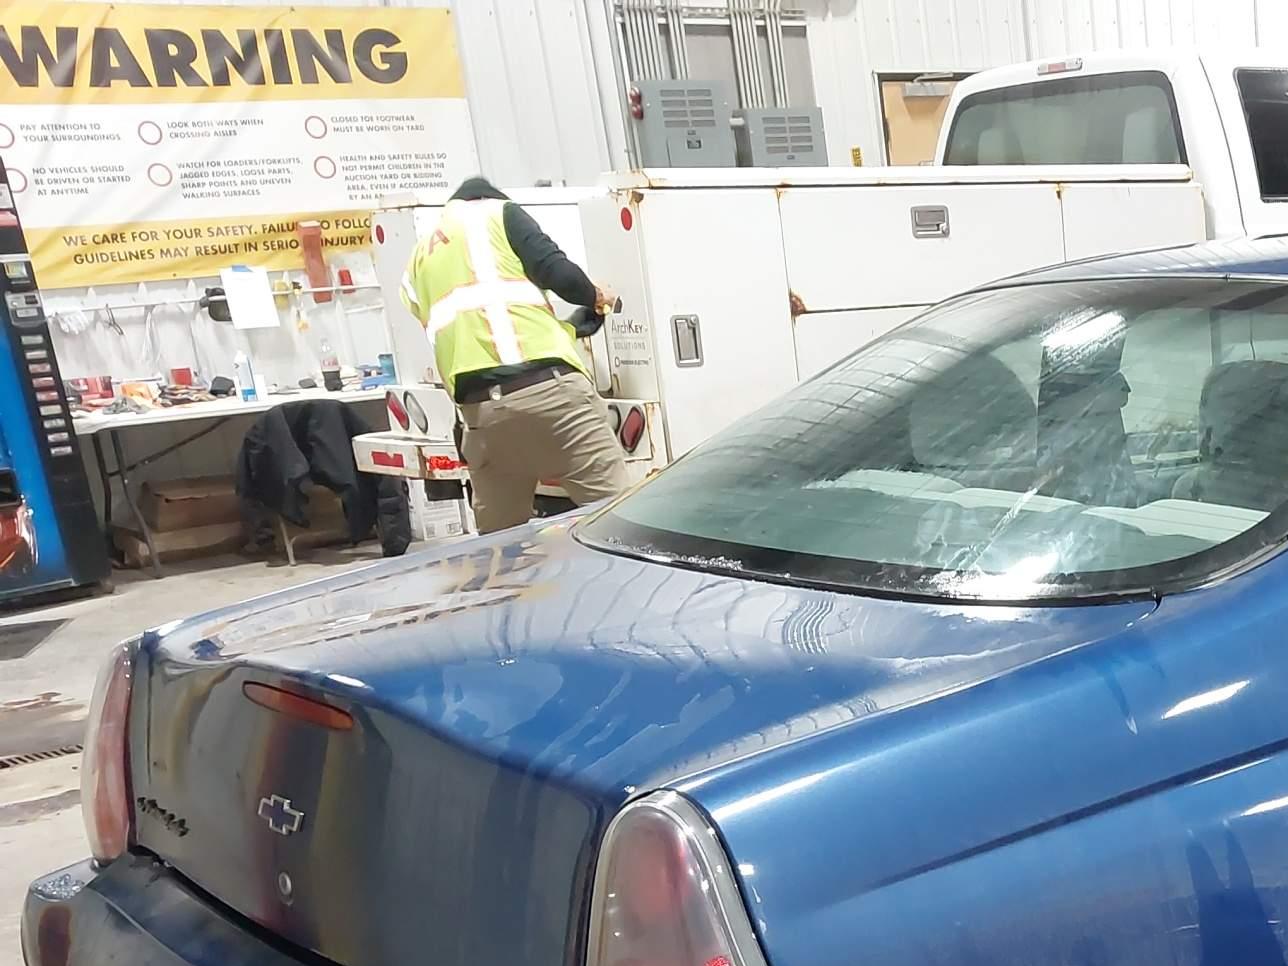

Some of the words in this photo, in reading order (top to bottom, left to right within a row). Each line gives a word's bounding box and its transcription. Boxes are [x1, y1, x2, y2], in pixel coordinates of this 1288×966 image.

[0, 25, 408, 88] WARNING
[167, 120, 189, 129] LOOK
[192, 119, 214, 128] BOTH
[216, 118, 239, 127] WAYS
[240, 118, 264, 126] WHEN
[330, 115, 359, 124] CLOSED
[360, 115, 374, 123] TOE
[376, 114, 415, 122] FOOTWEAR
[20, 123, 37, 131] PAY
[40, 123, 88, 131] ATTENTION
[89, 122, 101, 131] TO
[333, 125, 353, 133] MUST
[355, 125, 364, 133] BE
[366, 124, 391, 133] WORN
[392, 124, 405, 132] ON
[406, 124, 425, 132] YARD
[23, 134, 49, 142] YOUR
[50, 133, 121, 142] SURROUNDINGS
[169, 130, 211, 139] CROSSING
[213, 129, 238, 137] AISLES
[339, 154, 367, 163] HEALTH
[387, 153, 412, 161] SAFETY
[415, 152, 436, 160] RULES
[436, 152, 447, 160] DO
[32, 167, 47, 175] NO
[48, 166, 88, 175] VEHICLES
[90, 164, 125, 173] SHOULD
[177, 160, 205, 169] WATCH
[206, 160, 222, 169] FOR
[341, 164, 358, 172] NOT
[360, 163, 385, 172] PERMIT
[387, 163, 421, 171] CHILDREN
[423, 162, 432, 170] IN
[180, 171, 210, 180] JAGGED
[240, 168, 265, 177] LOOSE
[344, 173, 378, 182] AUCTION
[379, 173, 399, 181] YARD
[400, 172, 412, 180] OR
[34, 178, 45, 186] BE
[47, 176, 80, 185] DRIVEN
[82, 176, 95, 184] OR
[97, 174, 131, 184] STARTED
[180, 181, 206, 190] SHARP
[208, 179, 238, 188] POINTS
[240, 178, 258, 187] AND
[259, 177, 292, 187] UNEVEN
[369, 182, 389, 191] EVEN
[399, 181, 449, 190] ACCOMPANIED
[37, 188, 47, 196] AT
[51, 187, 89, 196] ANYTIME
[182, 190, 221, 200] WALKING
[223, 188, 261, 198] SURFACES
[349, 193, 358, 201] BY
[360, 193, 372, 201] AN
[63, 235, 88, 247] WE
[92, 231, 128, 245] CARE
[131, 230, 160, 243] FOR
[163, 227, 203, 240] YOUR
[207, 223, 258, 238] SAFETY.
[73, 248, 155, 265] GUIDELINES
[159, 246, 190, 259] MAY
[195, 243, 241, 257] RESULT
[244, 241, 258, 252] IN
[320, 235, 364, 248] INJURY
